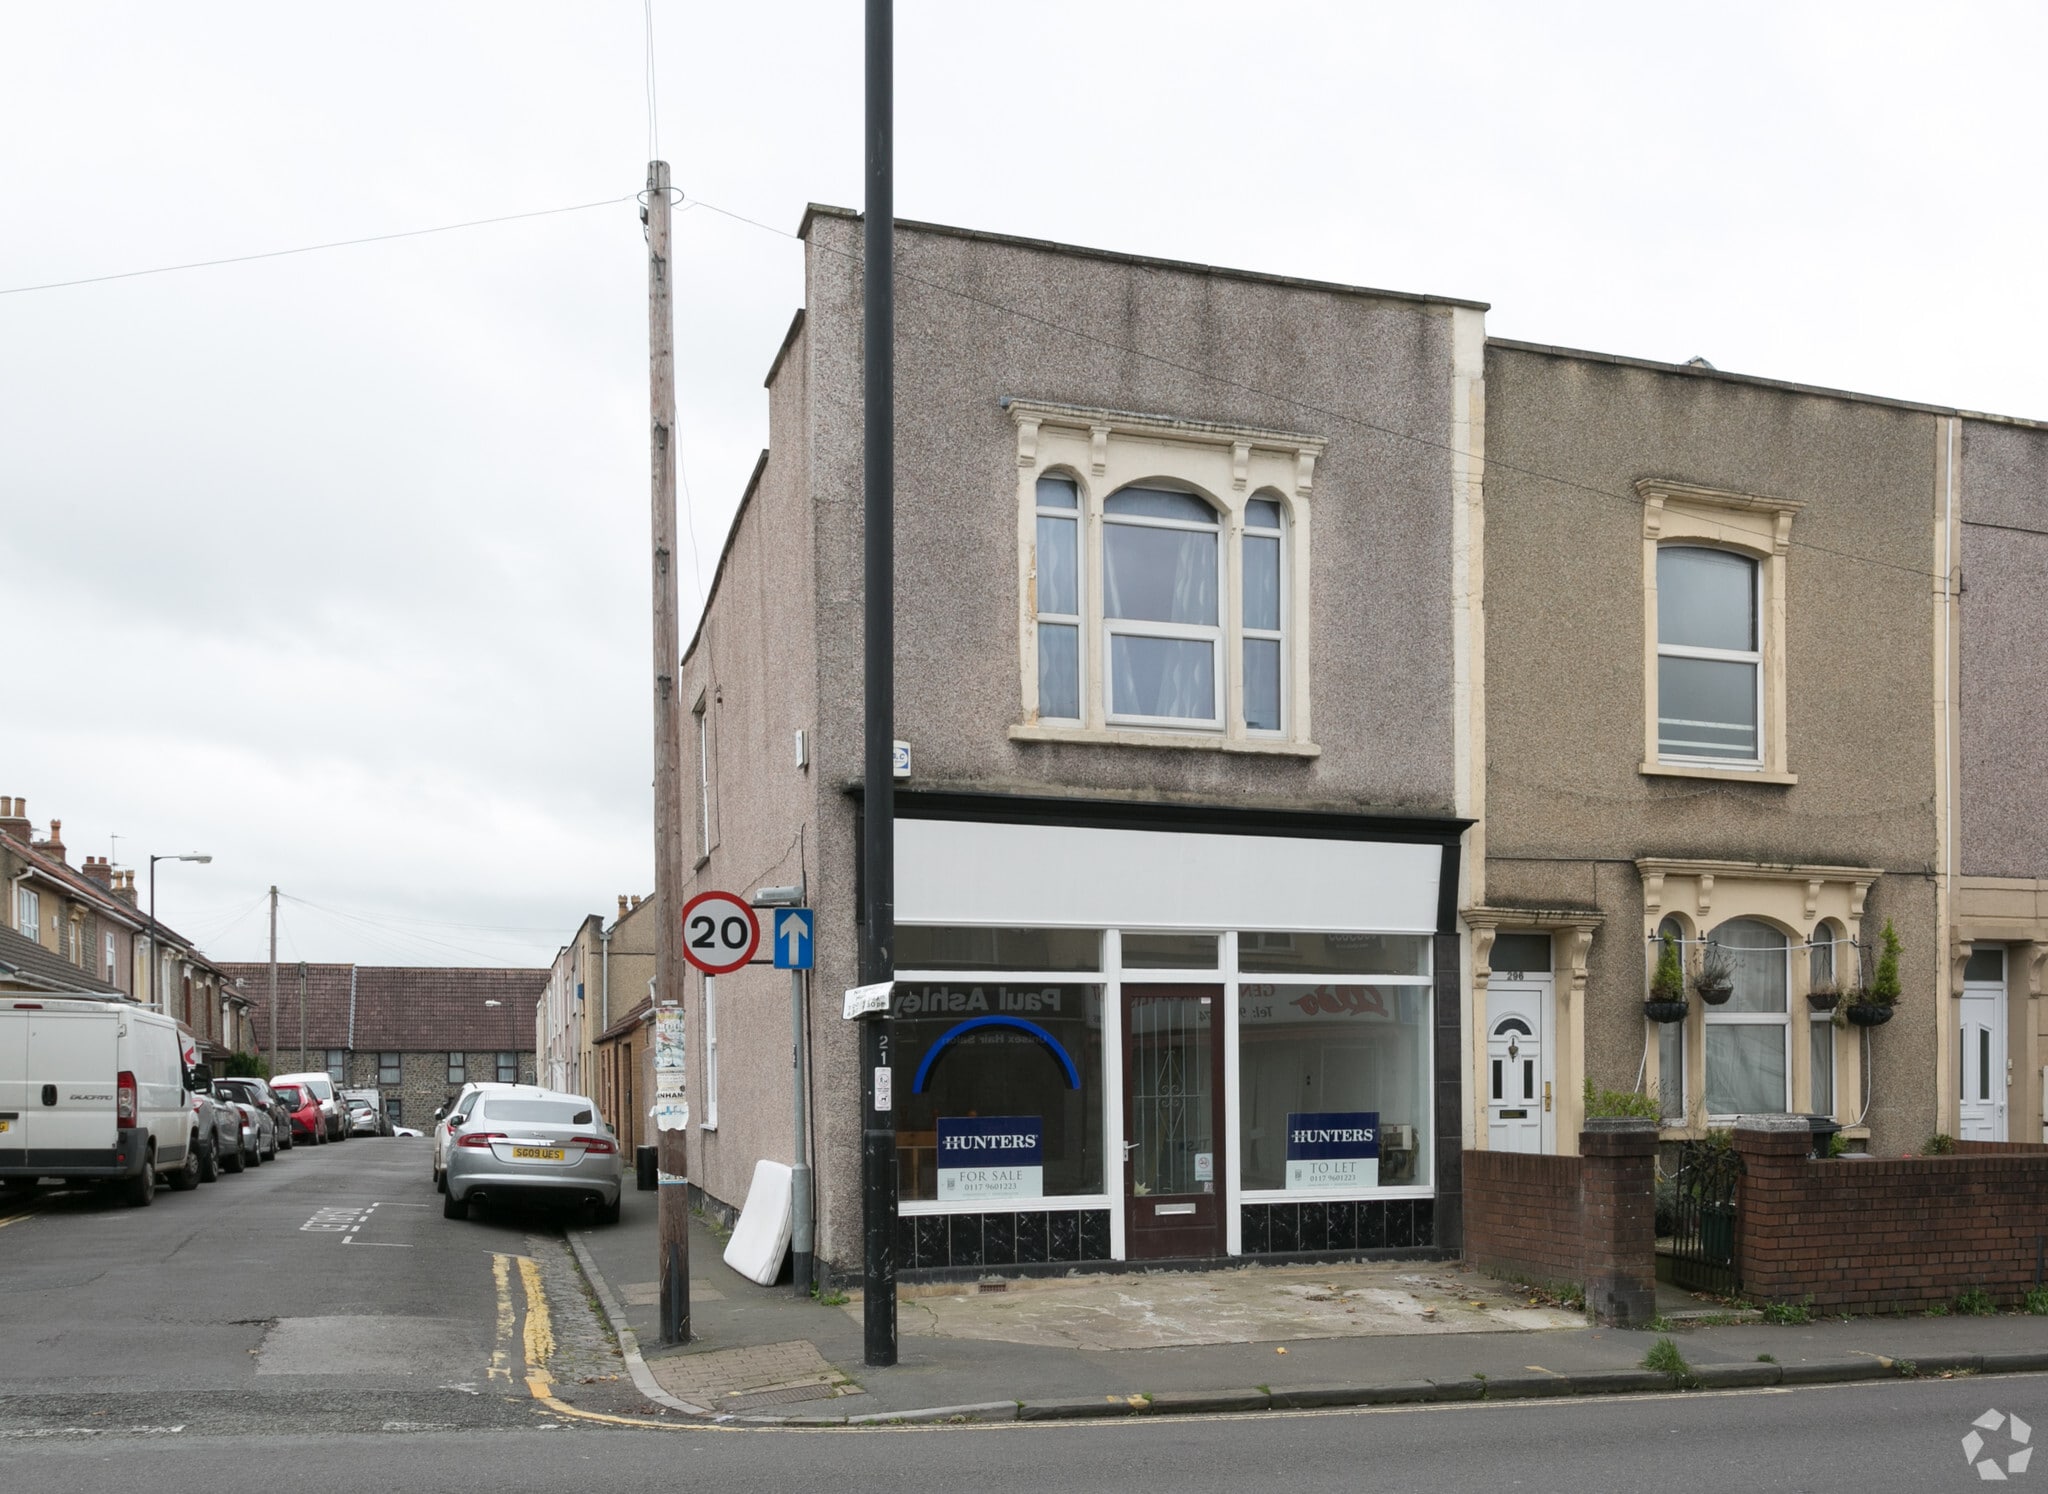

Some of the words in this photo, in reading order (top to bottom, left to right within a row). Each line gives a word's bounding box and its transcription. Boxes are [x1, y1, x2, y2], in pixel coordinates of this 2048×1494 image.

[690, 915, 748, 950] 20
[943, 1134, 1037, 1150] HUNTERS
[1291, 1128, 1375, 1143] HUNTERS
[1310, 1161, 1329, 1174] TO
[1334, 1161, 1357, 1173] LET
[960, 1171, 988, 1182] FOR
[992, 1170, 1023, 1181] SALE
[964, 1183, 983, 1191] 0117
